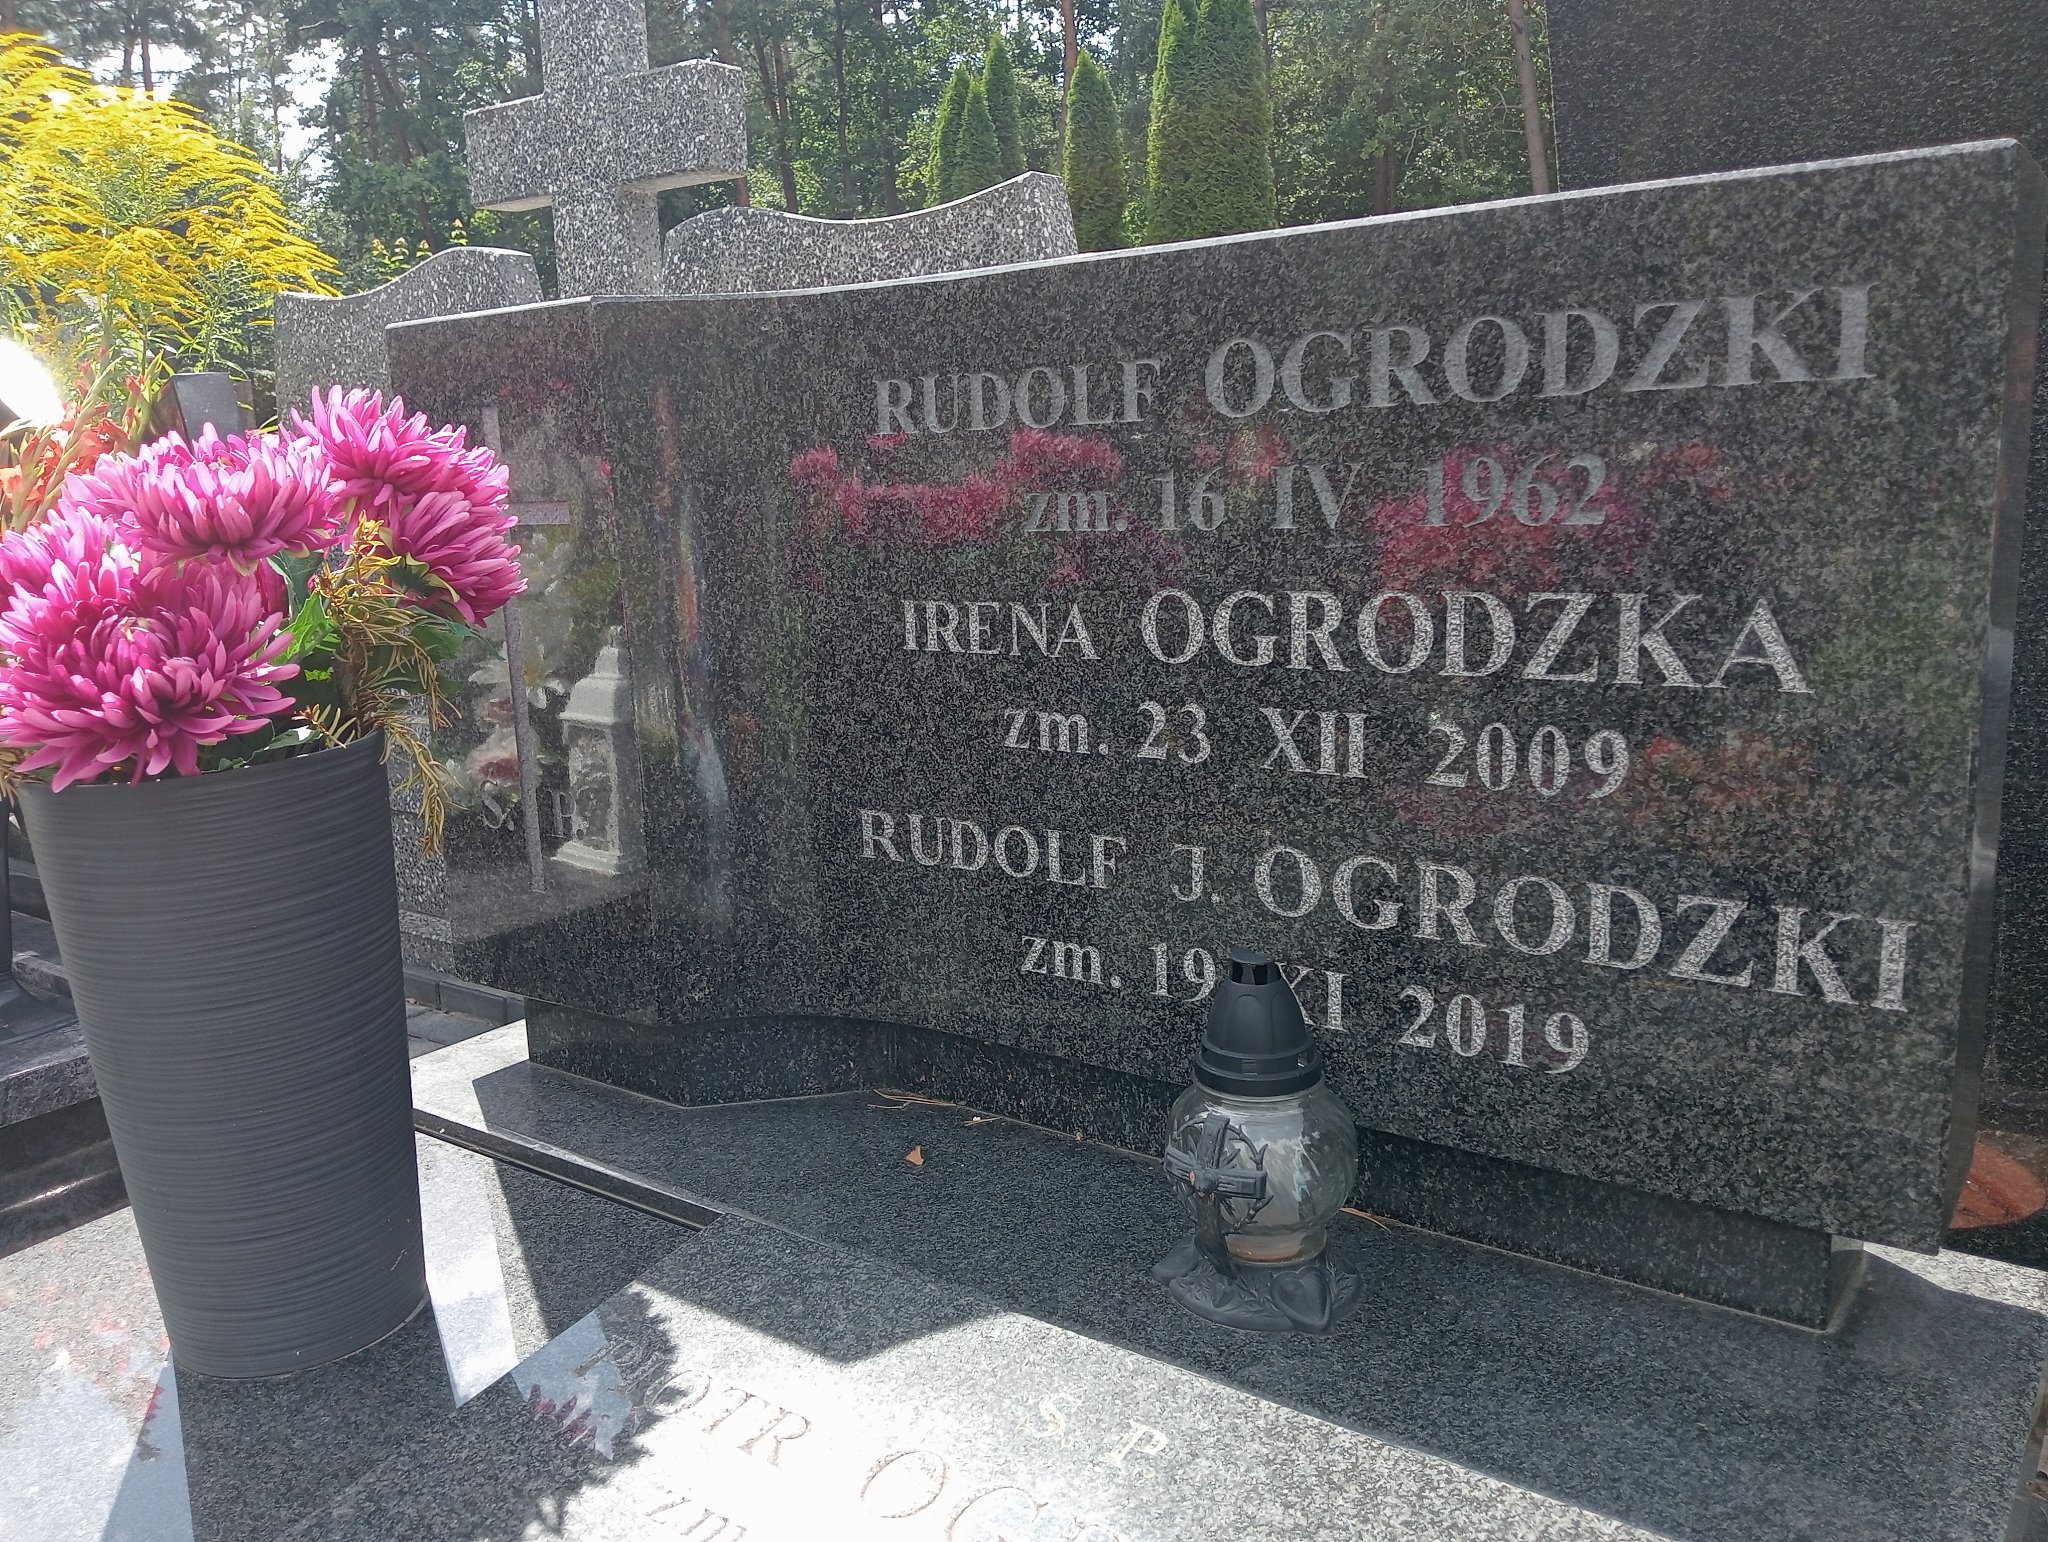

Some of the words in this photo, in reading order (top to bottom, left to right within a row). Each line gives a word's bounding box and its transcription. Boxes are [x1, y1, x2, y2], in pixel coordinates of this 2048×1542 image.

[873, 359, 1160, 435] RUDOLF
[1204, 284, 1877, 418] OGRODZKI
[1023, 488, 1129, 532] zm.
[1150, 466, 1226, 531] 16
[1271, 461, 1368, 531] IV
[1416, 453, 1608, 527] 1962
[902, 599, 1102, 660] IRENA
[1140, 588, 1816, 694] OGRODZKA
[1003, 706, 1109, 756] zm.
[1136, 700, 1212, 763] 23
[1259, 706, 1370, 779] XII
[1424, 720, 1631, 800] 2009
[858, 808, 1128, 889] RUDOLF
[1169, 844, 1220, 902] J.
[1254, 845, 1918, 1012] OGRODZKI
[1021, 935, 1122, 989] zm.
[1148, 942, 1216, 1002] 19
[1400, 987, 1591, 1074] 2019
